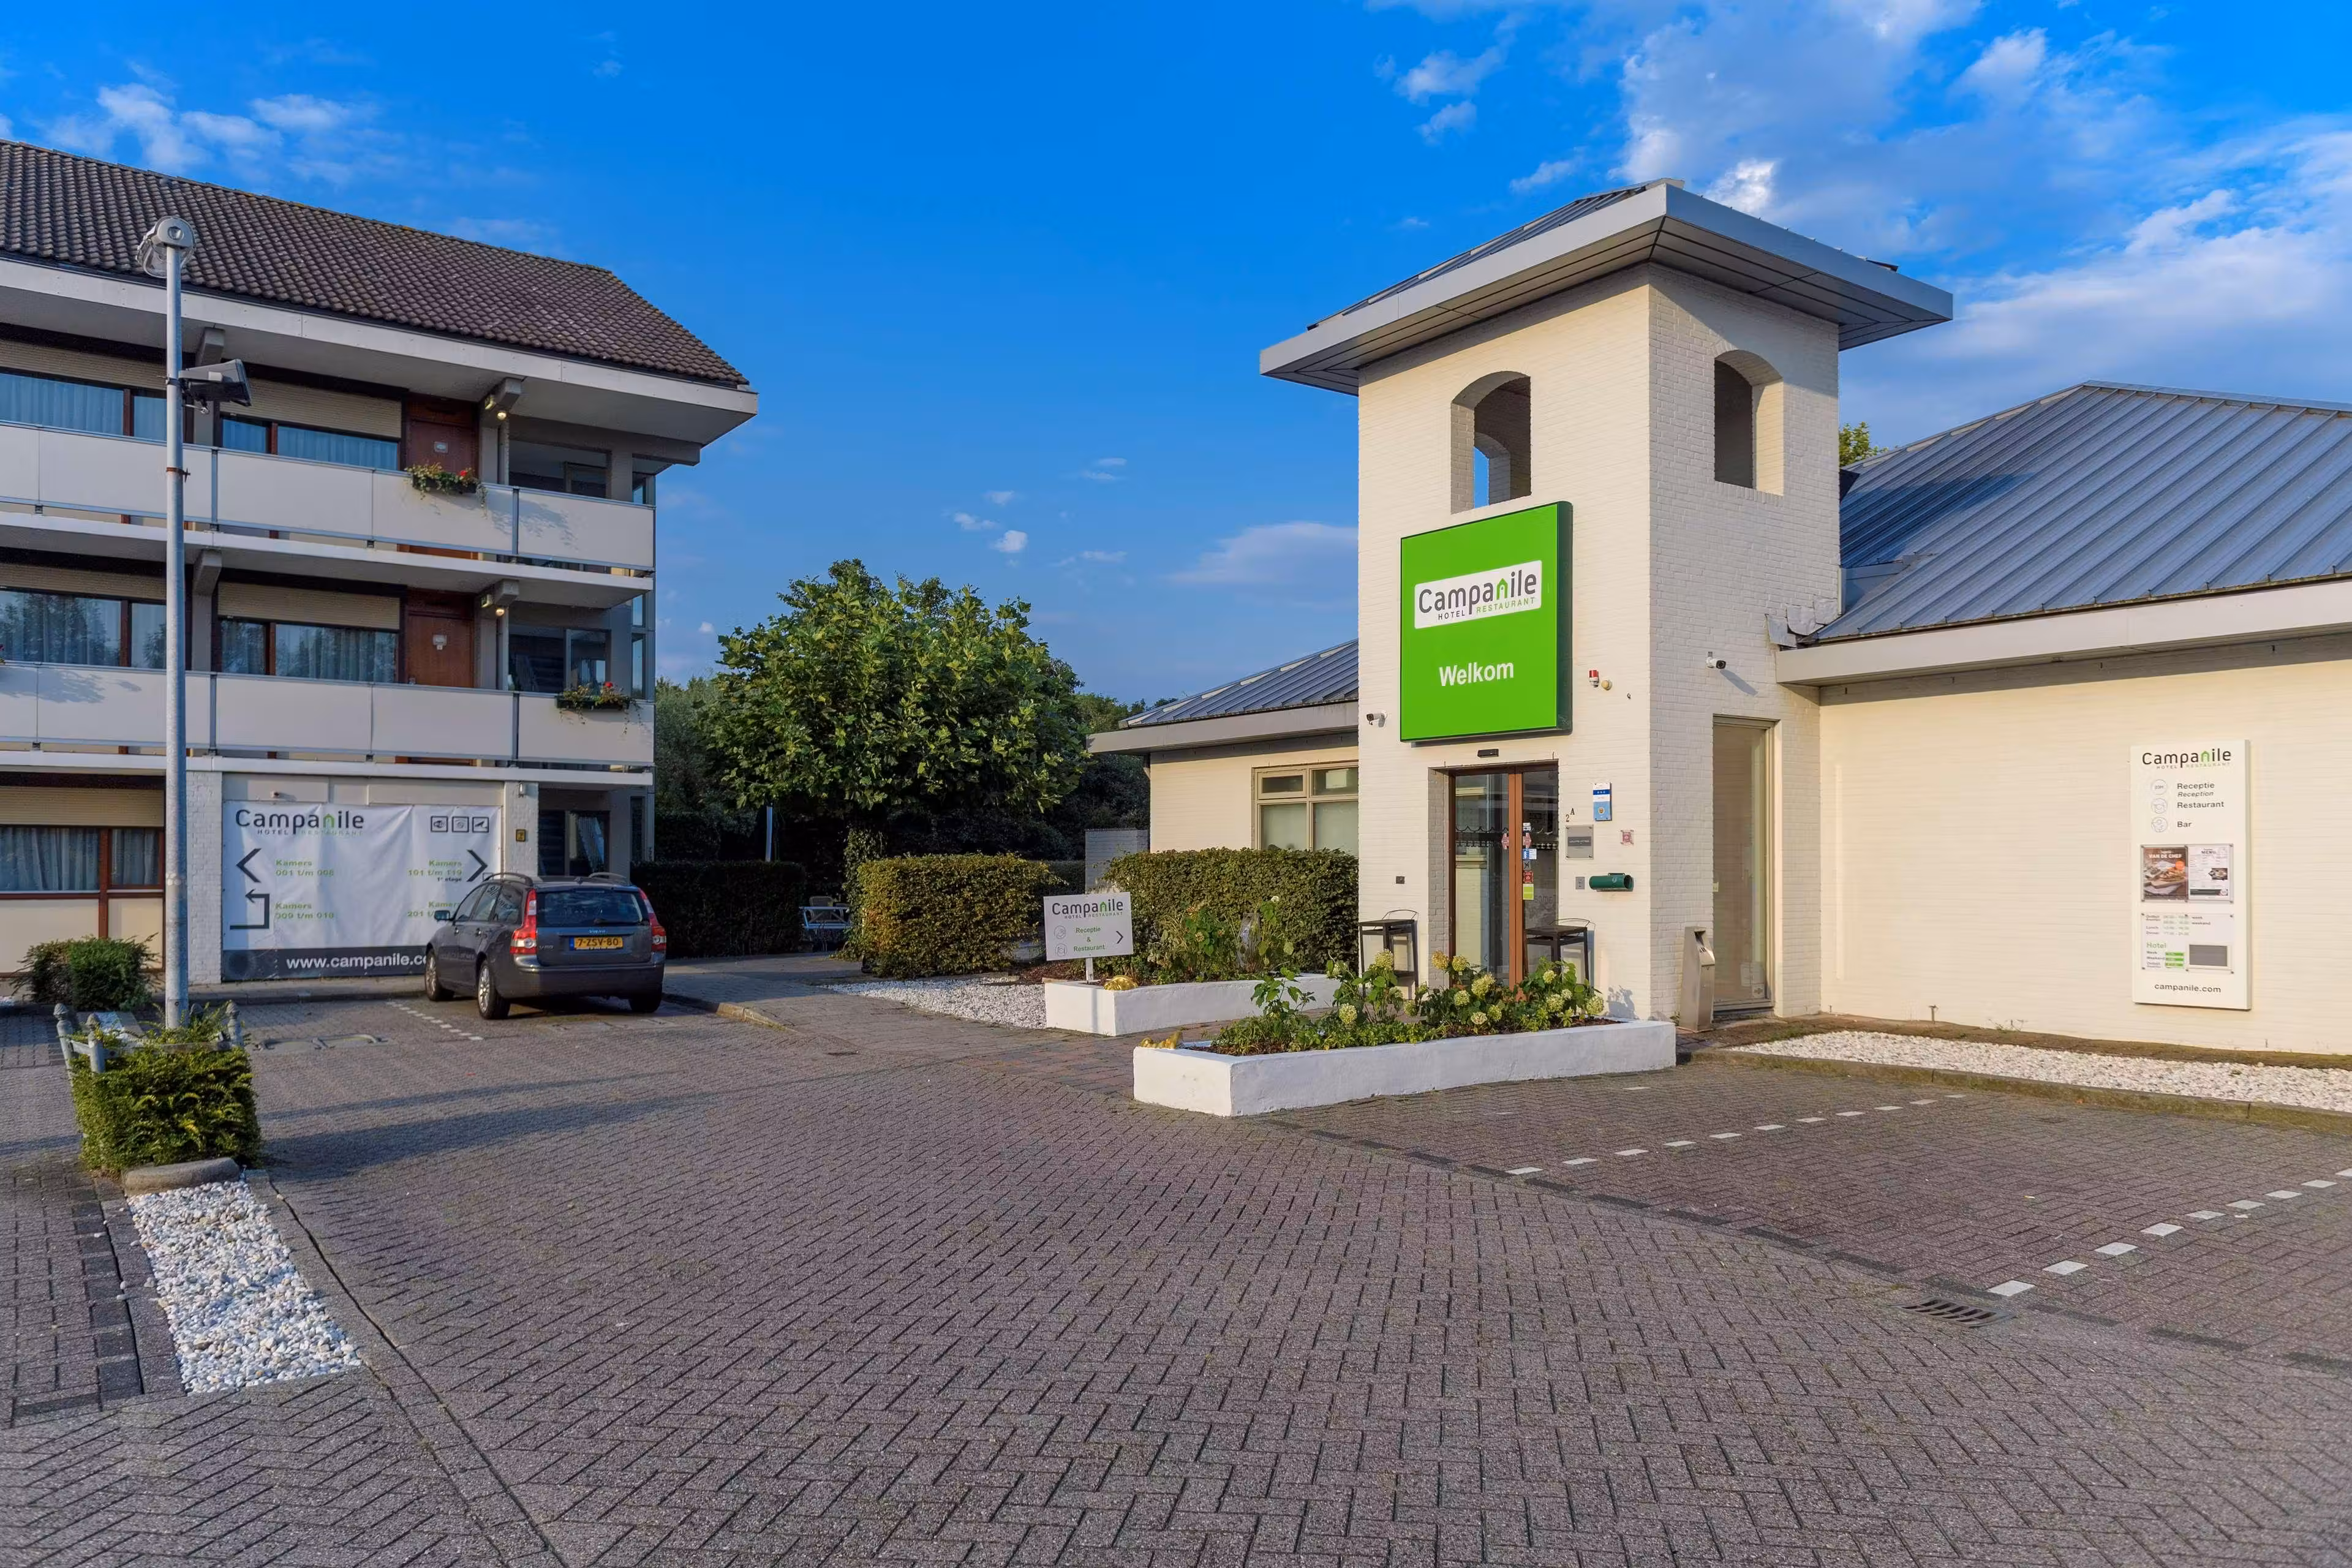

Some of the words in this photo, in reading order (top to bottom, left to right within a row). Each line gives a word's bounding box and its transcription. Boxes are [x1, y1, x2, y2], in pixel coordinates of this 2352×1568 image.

[1419, 569, 1537, 615] Campanile
[1438, 609, 1466, 620] HOTEL
[1476, 597, 1536, 614] RESTAURANT
[1439, 662, 1514, 687] Welkom
[2142, 748, 2232, 769] Campanile
[235, 810, 364, 834] Campanile
[1052, 899, 1123, 918] Campanile
[577, 937, 619, 947] 7-ZSV-80
[2154, 982, 2222, 993] campanile.com
